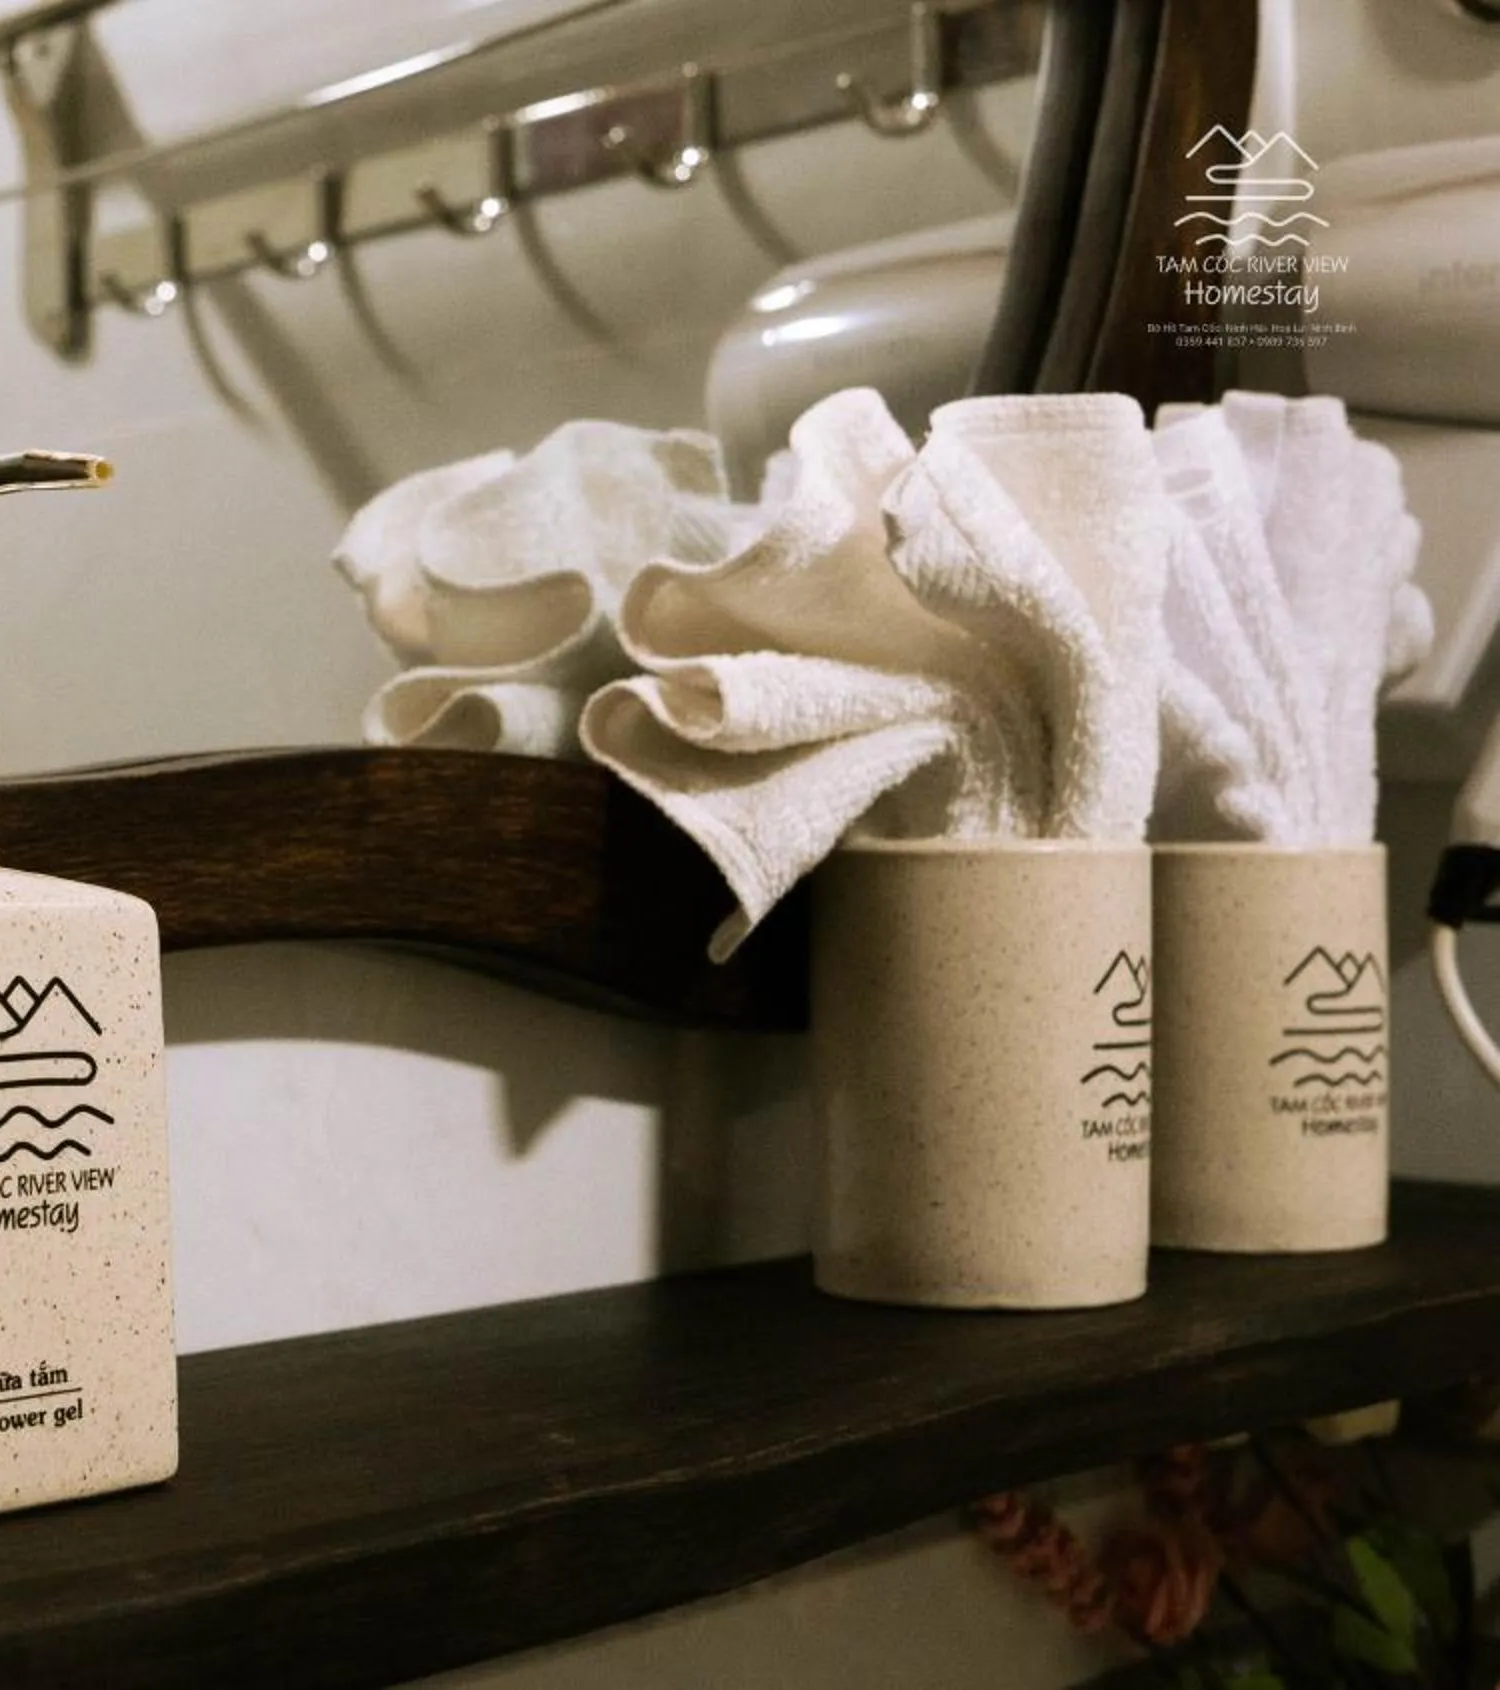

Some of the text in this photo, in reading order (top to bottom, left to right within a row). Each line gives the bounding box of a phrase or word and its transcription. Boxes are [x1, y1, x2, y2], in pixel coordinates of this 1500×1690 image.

[17, 1171, 67, 1196] RIVER
[71, 1167, 115, 1191] VIEW
[53, 1397, 84, 1428] gel
